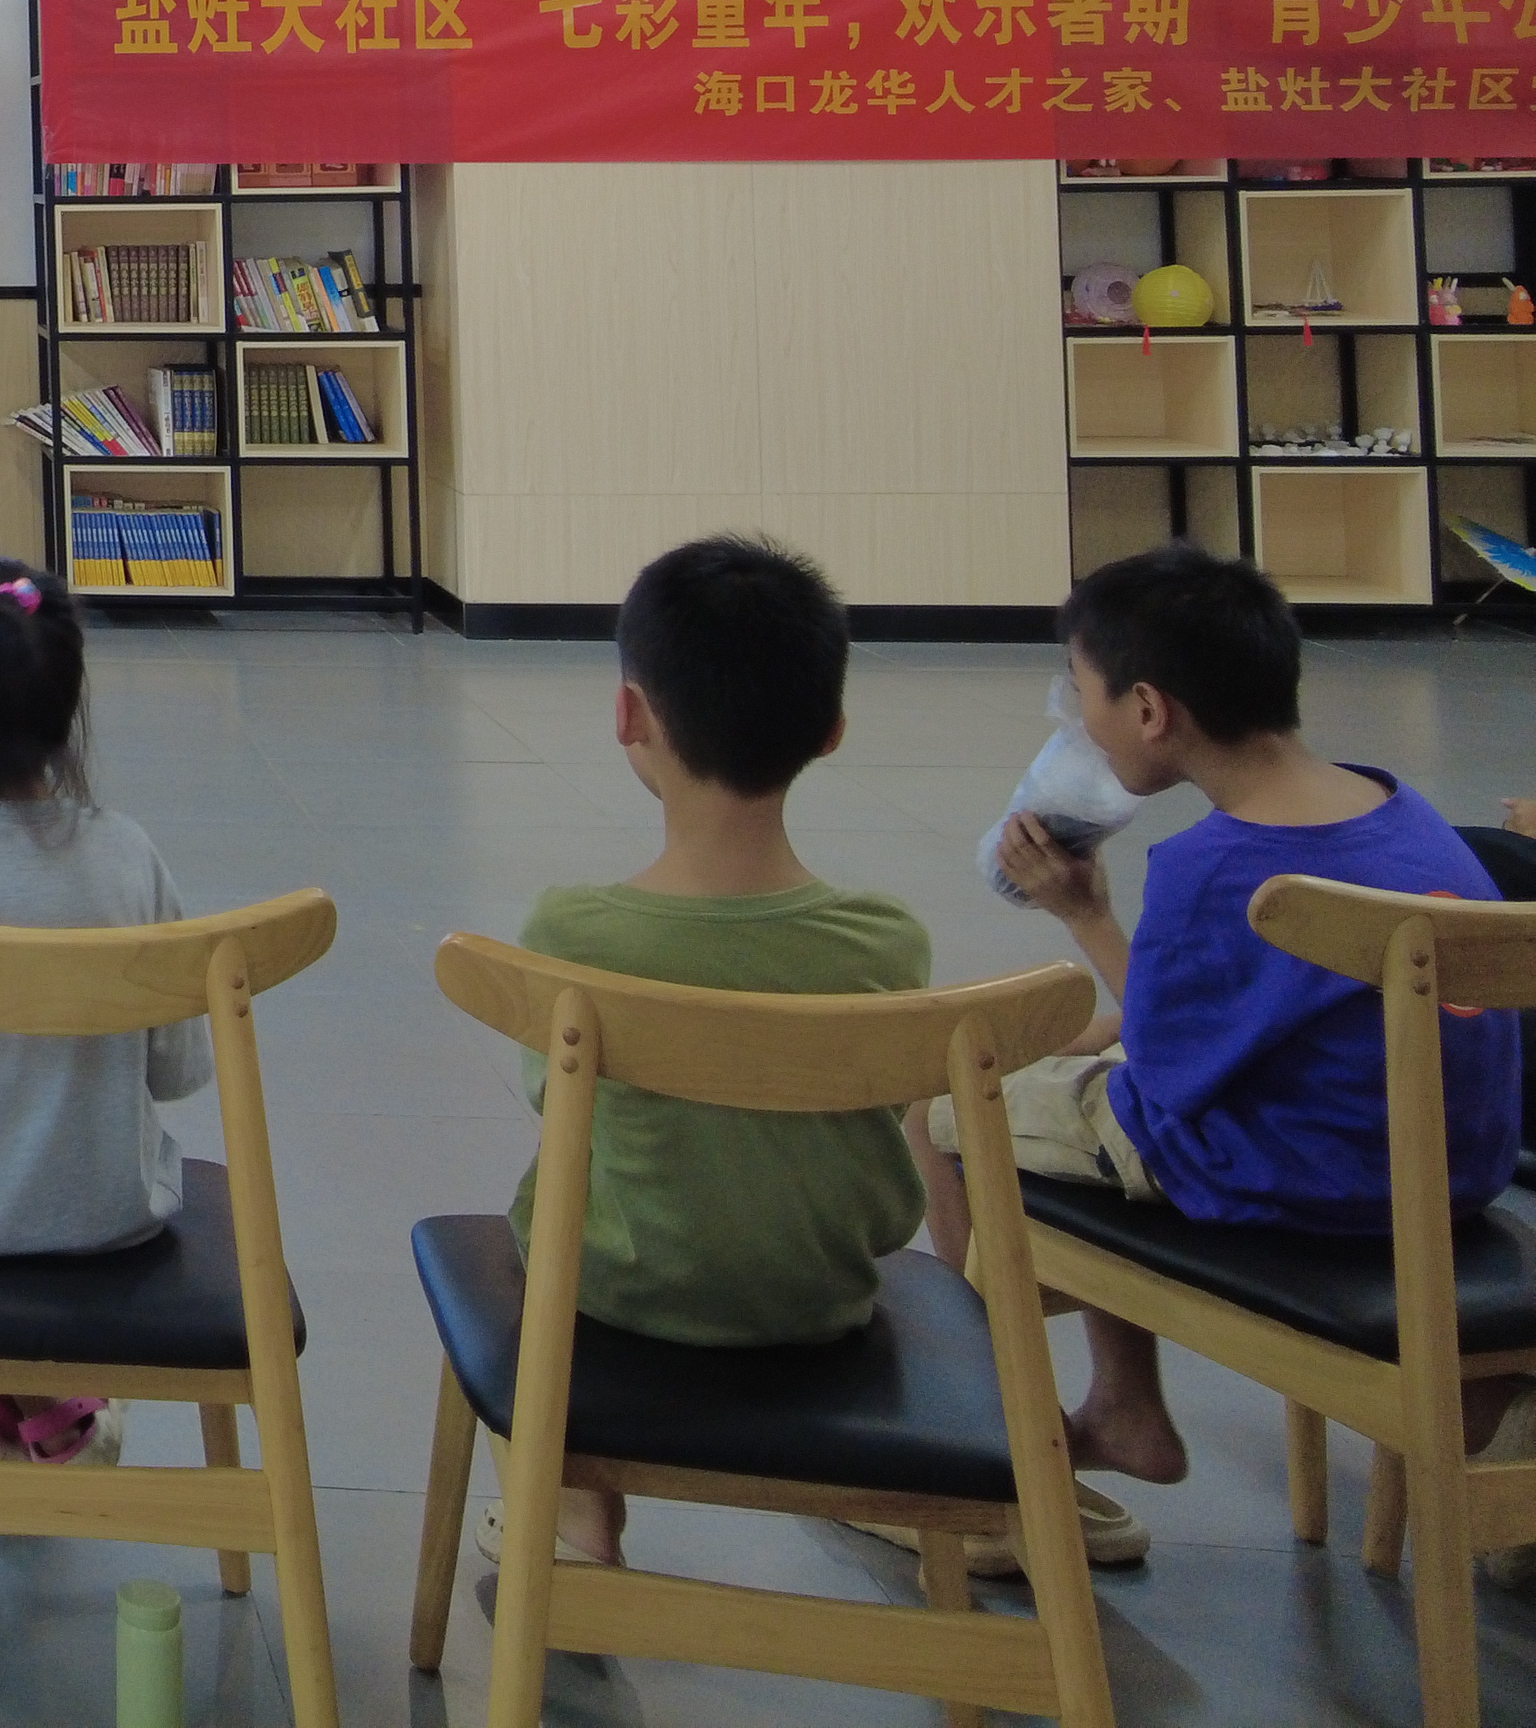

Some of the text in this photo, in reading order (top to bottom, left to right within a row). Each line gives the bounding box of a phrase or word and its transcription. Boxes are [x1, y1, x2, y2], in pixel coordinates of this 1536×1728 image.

[692, 65, 1536, 117] 海口龙华人才之家、盐灶大社区
